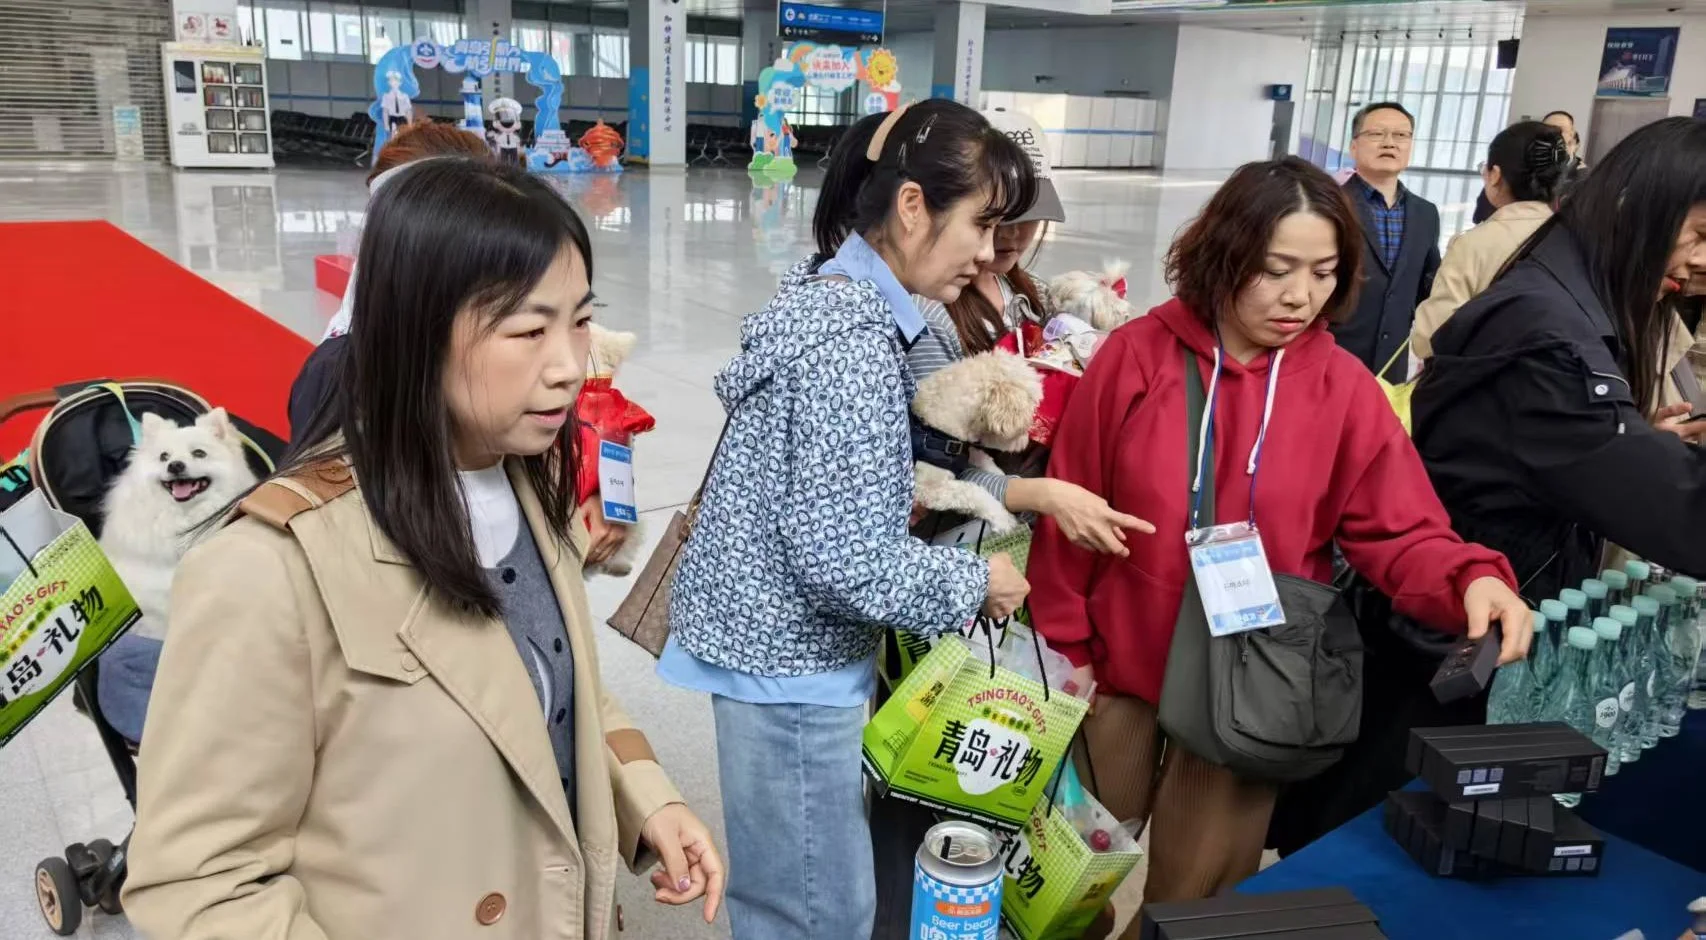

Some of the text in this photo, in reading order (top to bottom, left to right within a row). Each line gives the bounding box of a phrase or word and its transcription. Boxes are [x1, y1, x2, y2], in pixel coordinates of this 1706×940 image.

[37, 580, 68, 599] GIFT
[0, 585, 104, 709] 岛礼物
[967, 687, 1035, 712] TSINGTAO'S
[1031, 707, 1047, 735] GIFT
[934, 719, 1043, 787] 青岛礼物
[1033, 817, 1047, 851] GIFT
[931, 915, 993, 931] Beer bean
